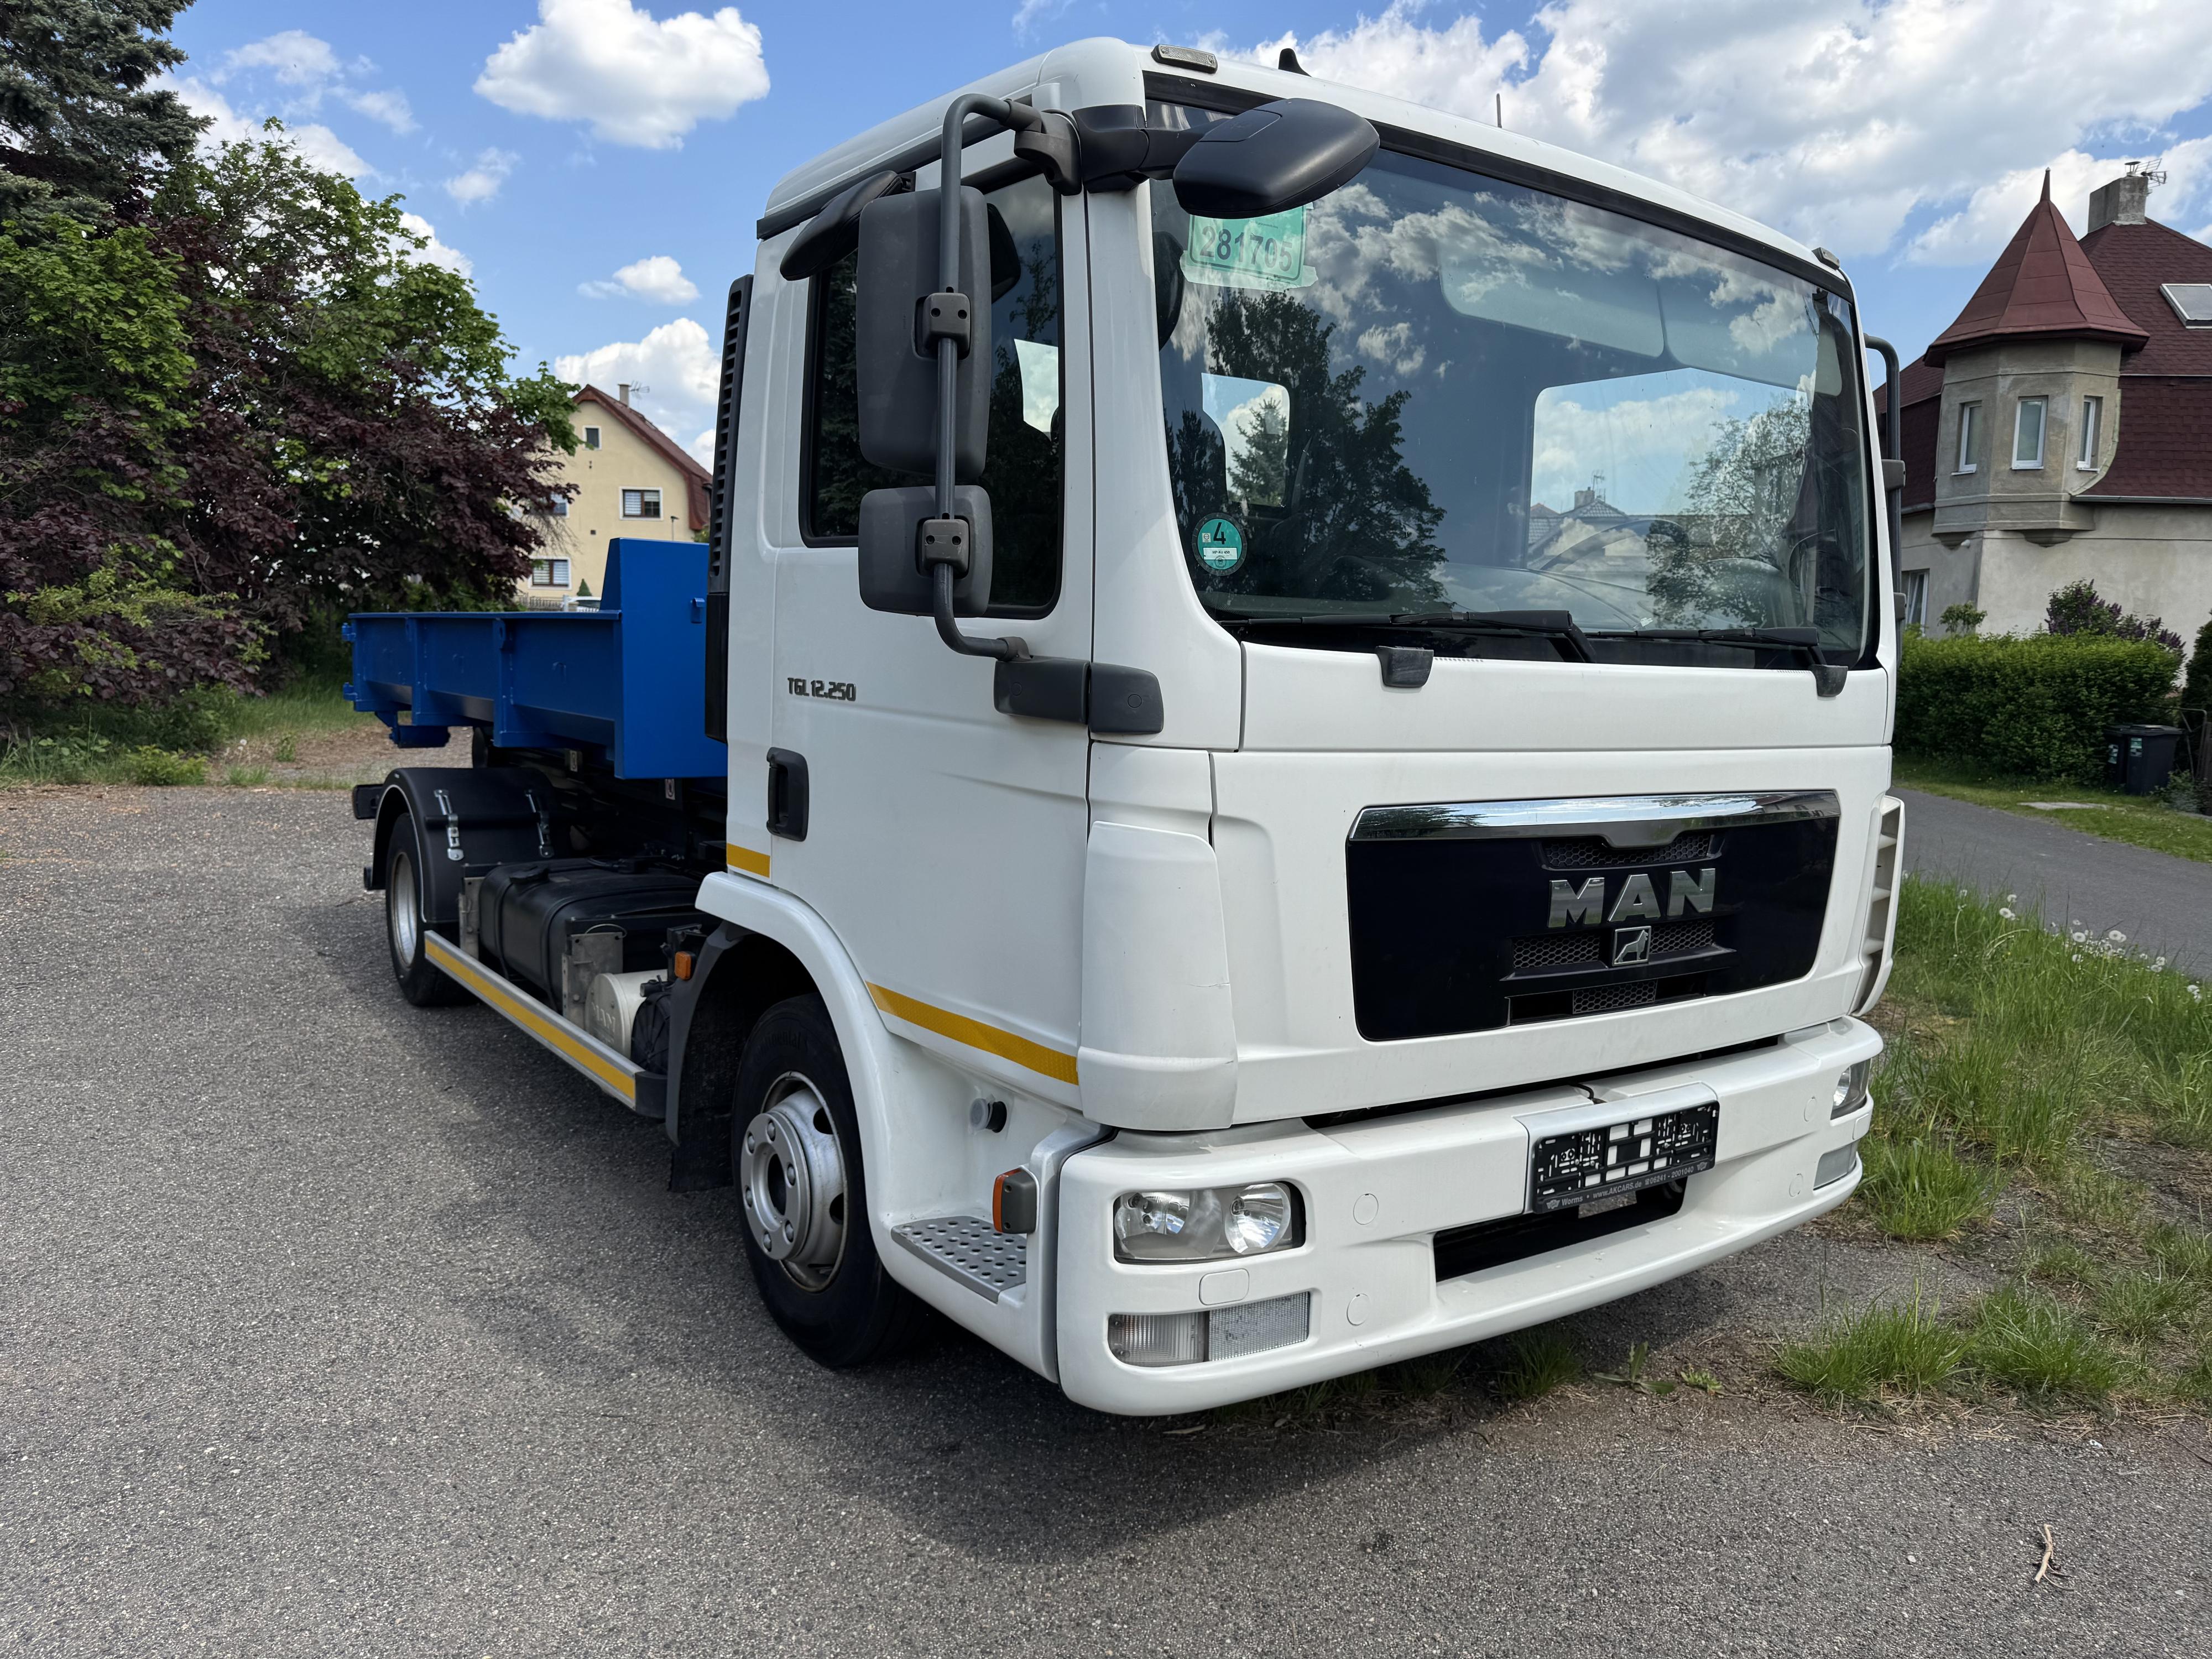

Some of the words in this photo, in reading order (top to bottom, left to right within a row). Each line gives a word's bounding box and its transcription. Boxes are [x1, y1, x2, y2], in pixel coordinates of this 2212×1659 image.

[1199, 225, 1293, 272] 281705
[1213, 521, 1227, 545] 4
[787, 677, 810, 697] TGL
[810, 680, 857, 702] 12.250
[1547, 868, 1716, 928] MAN
[1561, 1196, 1583, 1206] Worms
[1592, 1181, 1642, 1199] www.AKCARS.de
[1671, 1166, 1694, 1178] 2001040
